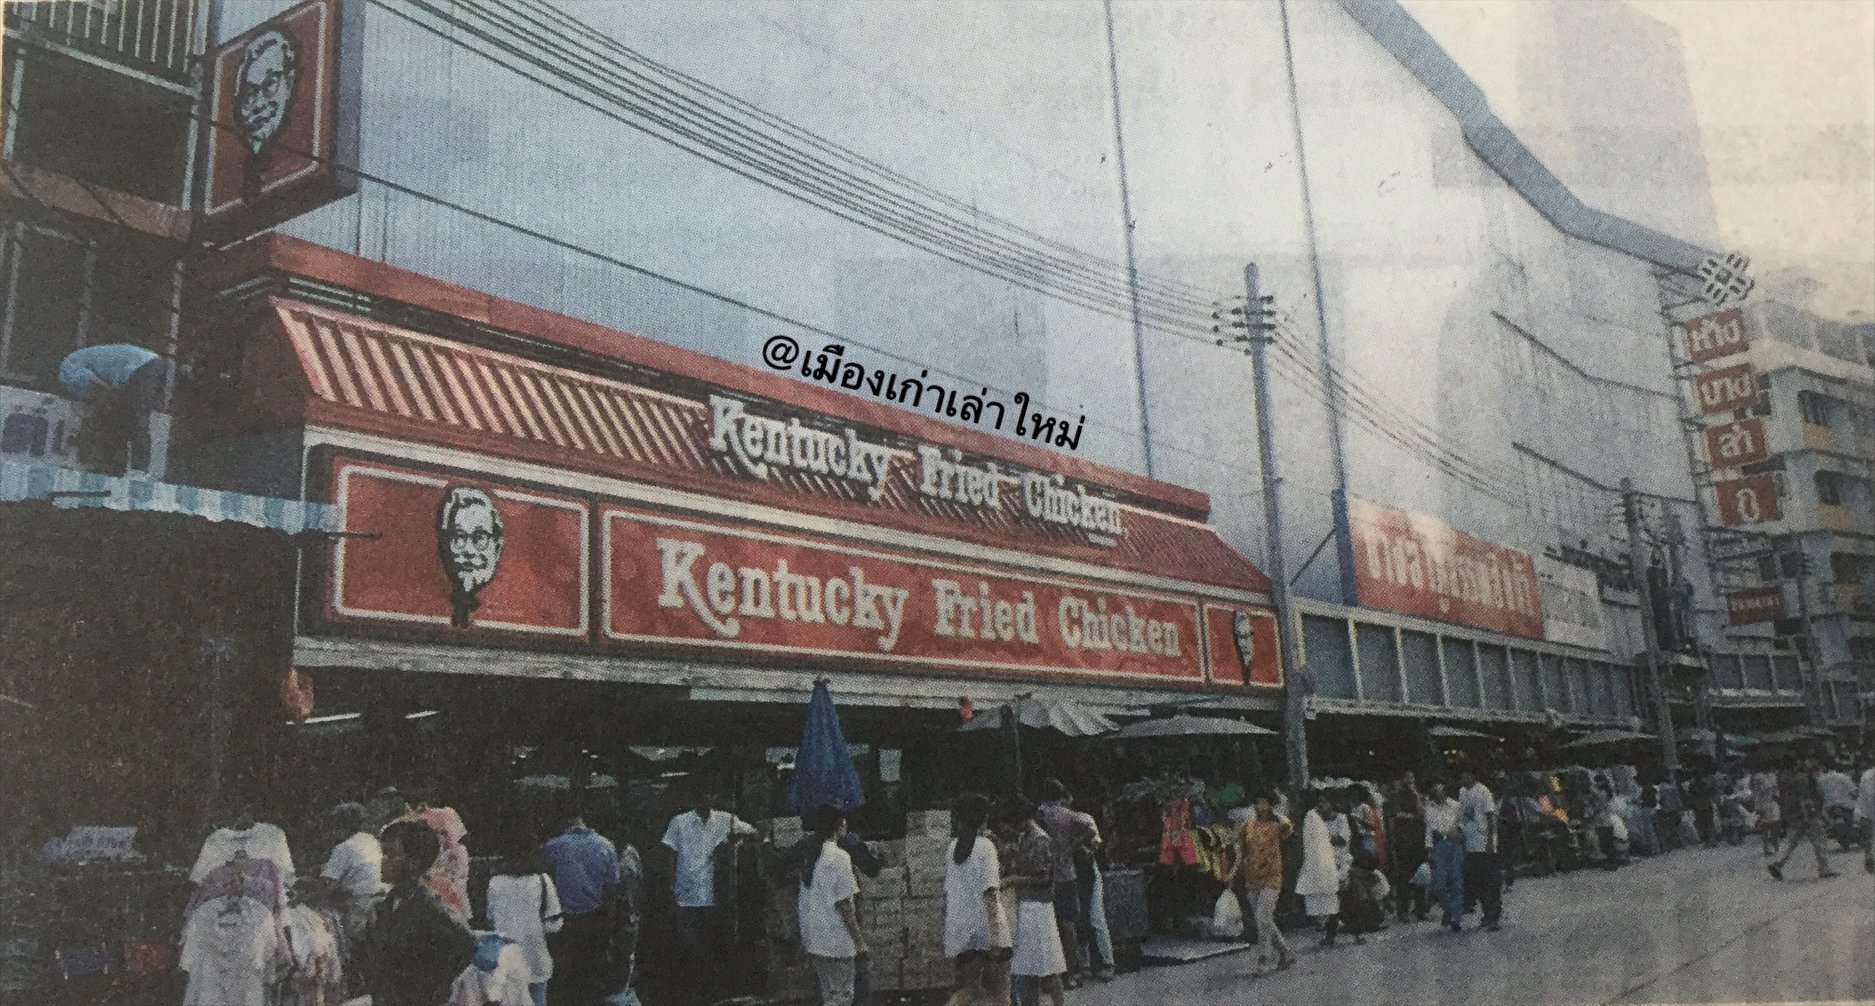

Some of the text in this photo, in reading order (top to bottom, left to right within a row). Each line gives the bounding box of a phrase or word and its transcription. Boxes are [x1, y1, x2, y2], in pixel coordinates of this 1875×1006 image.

[708, 395, 1122, 536] Kentucky Fried Chicken
[656, 536, 1181, 659] Kentucky Fried Chicken
